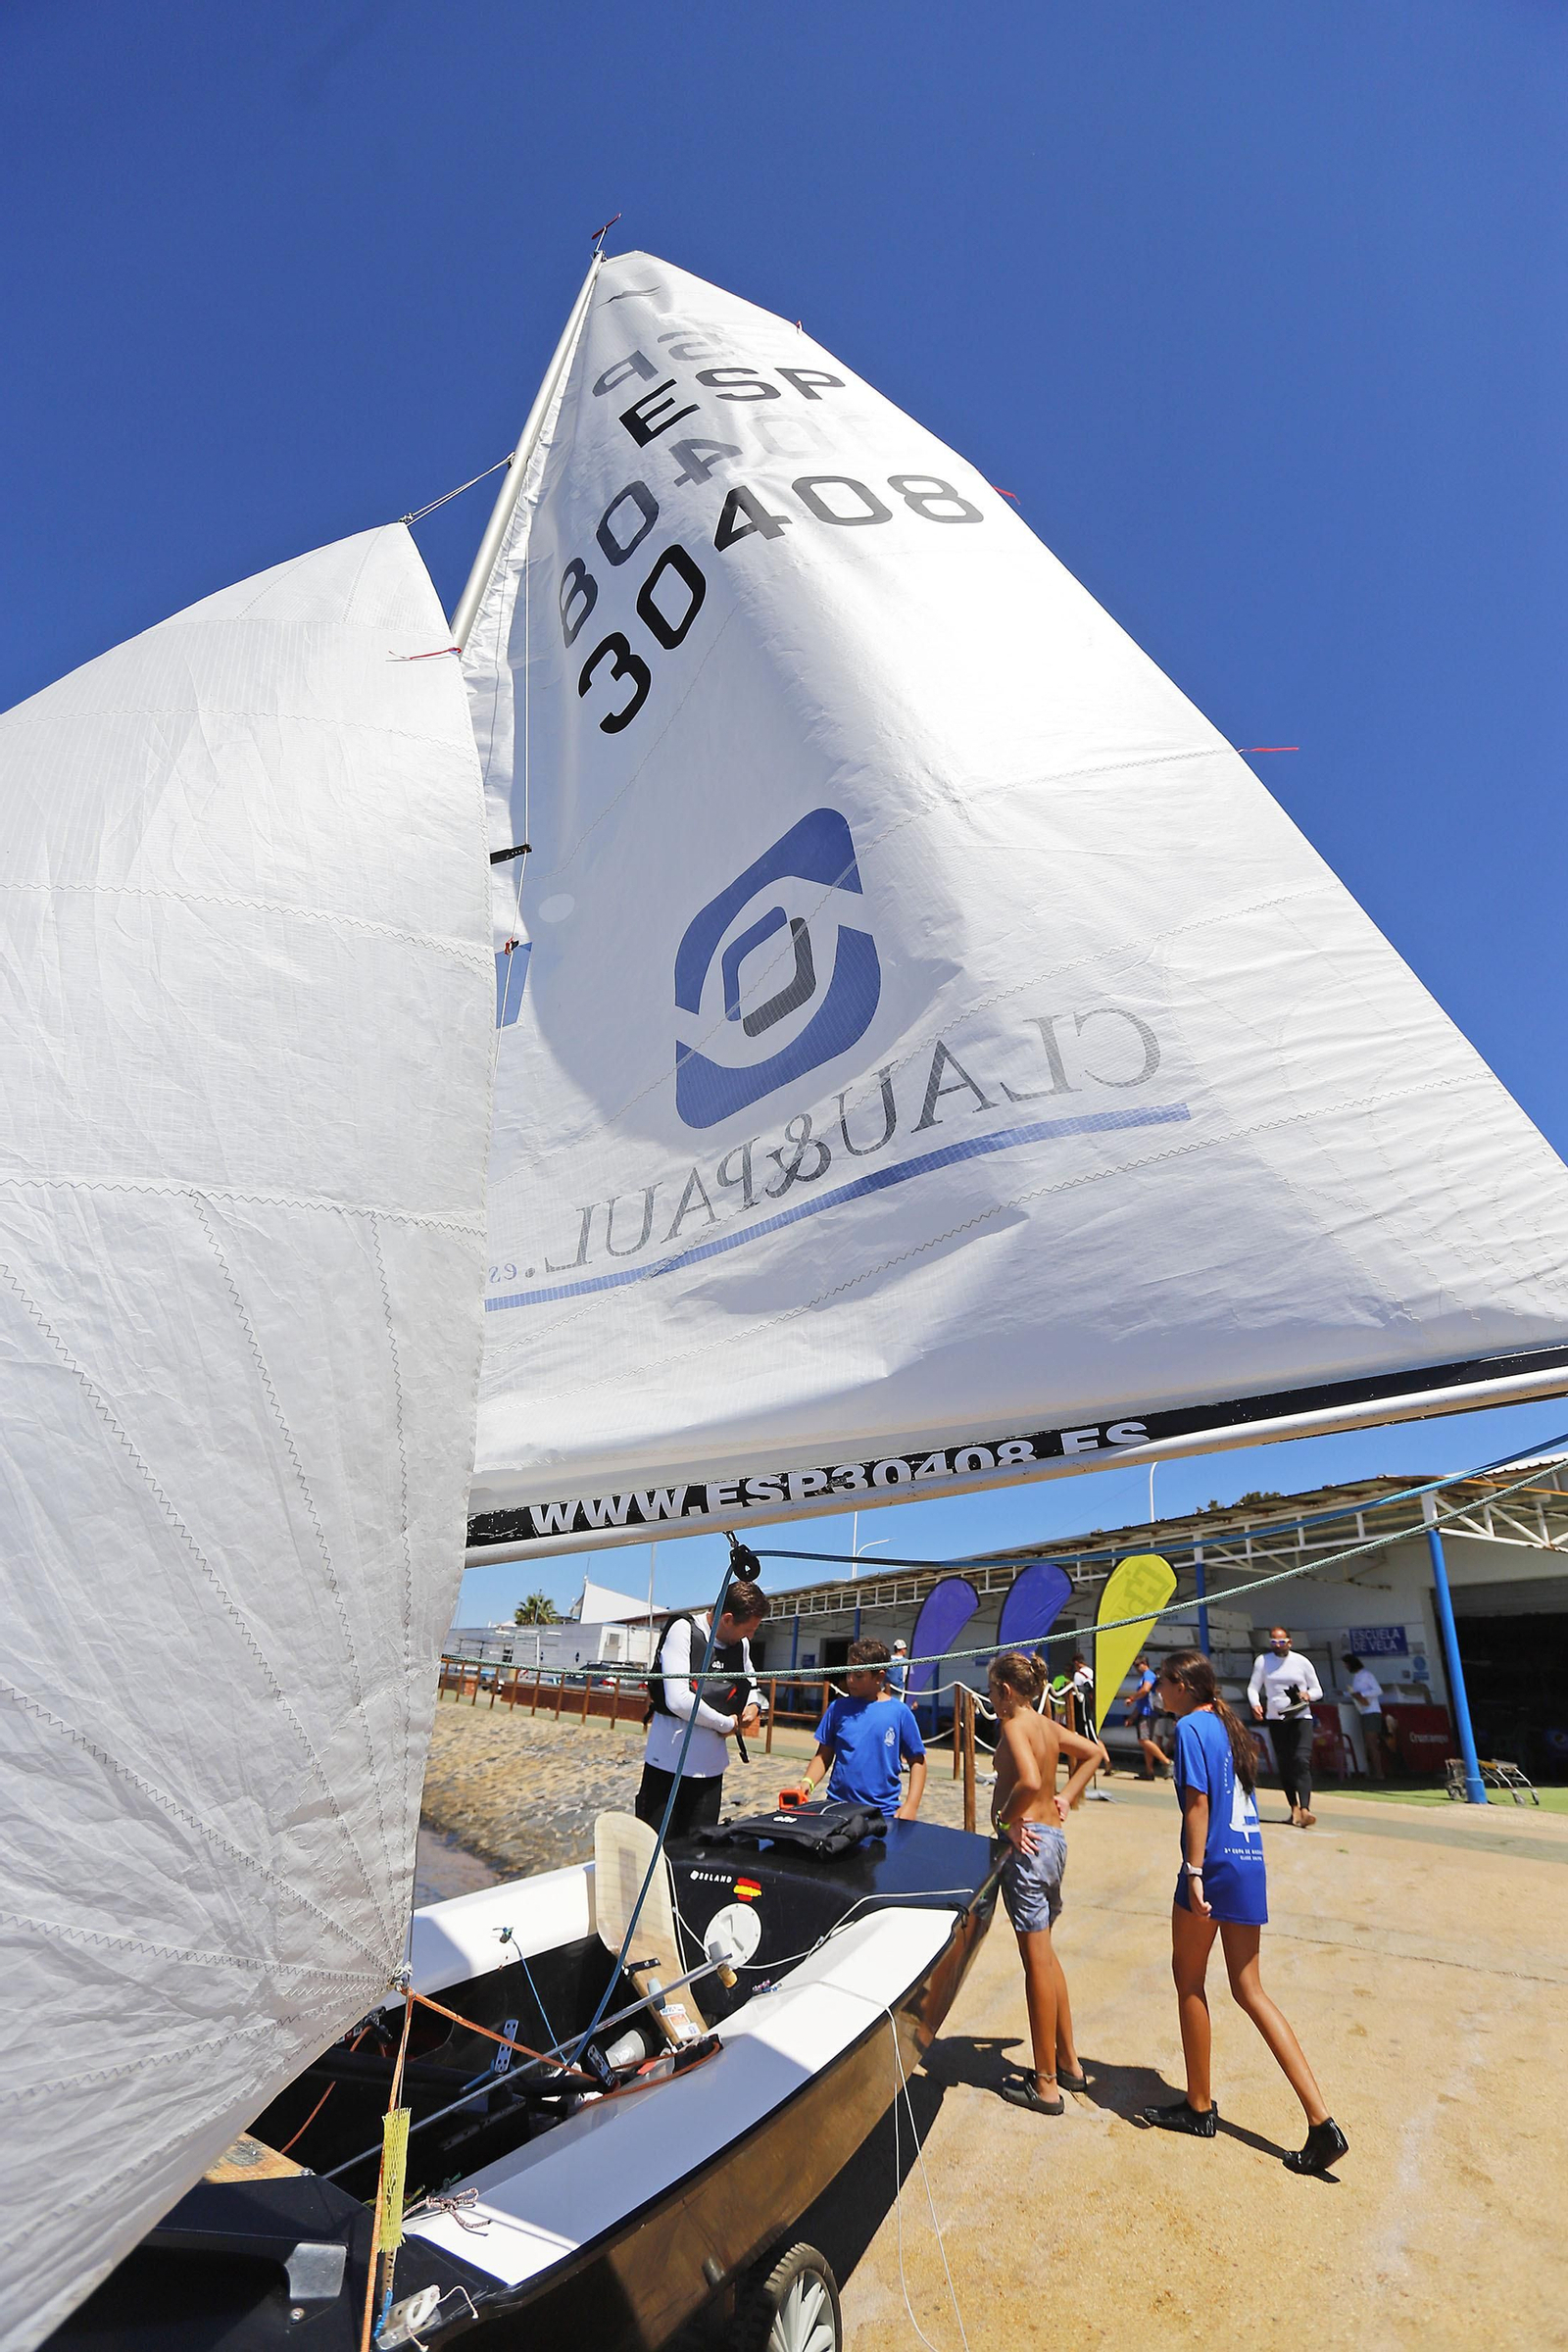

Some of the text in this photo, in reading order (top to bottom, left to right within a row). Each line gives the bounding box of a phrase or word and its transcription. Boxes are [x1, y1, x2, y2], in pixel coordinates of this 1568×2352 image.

[618, 368, 846, 448] ESP
[578, 474, 985, 734] 30408
[1351, 1628, 1401, 1641] ESCUELA
[1353, 1641, 1368, 1652] DE
